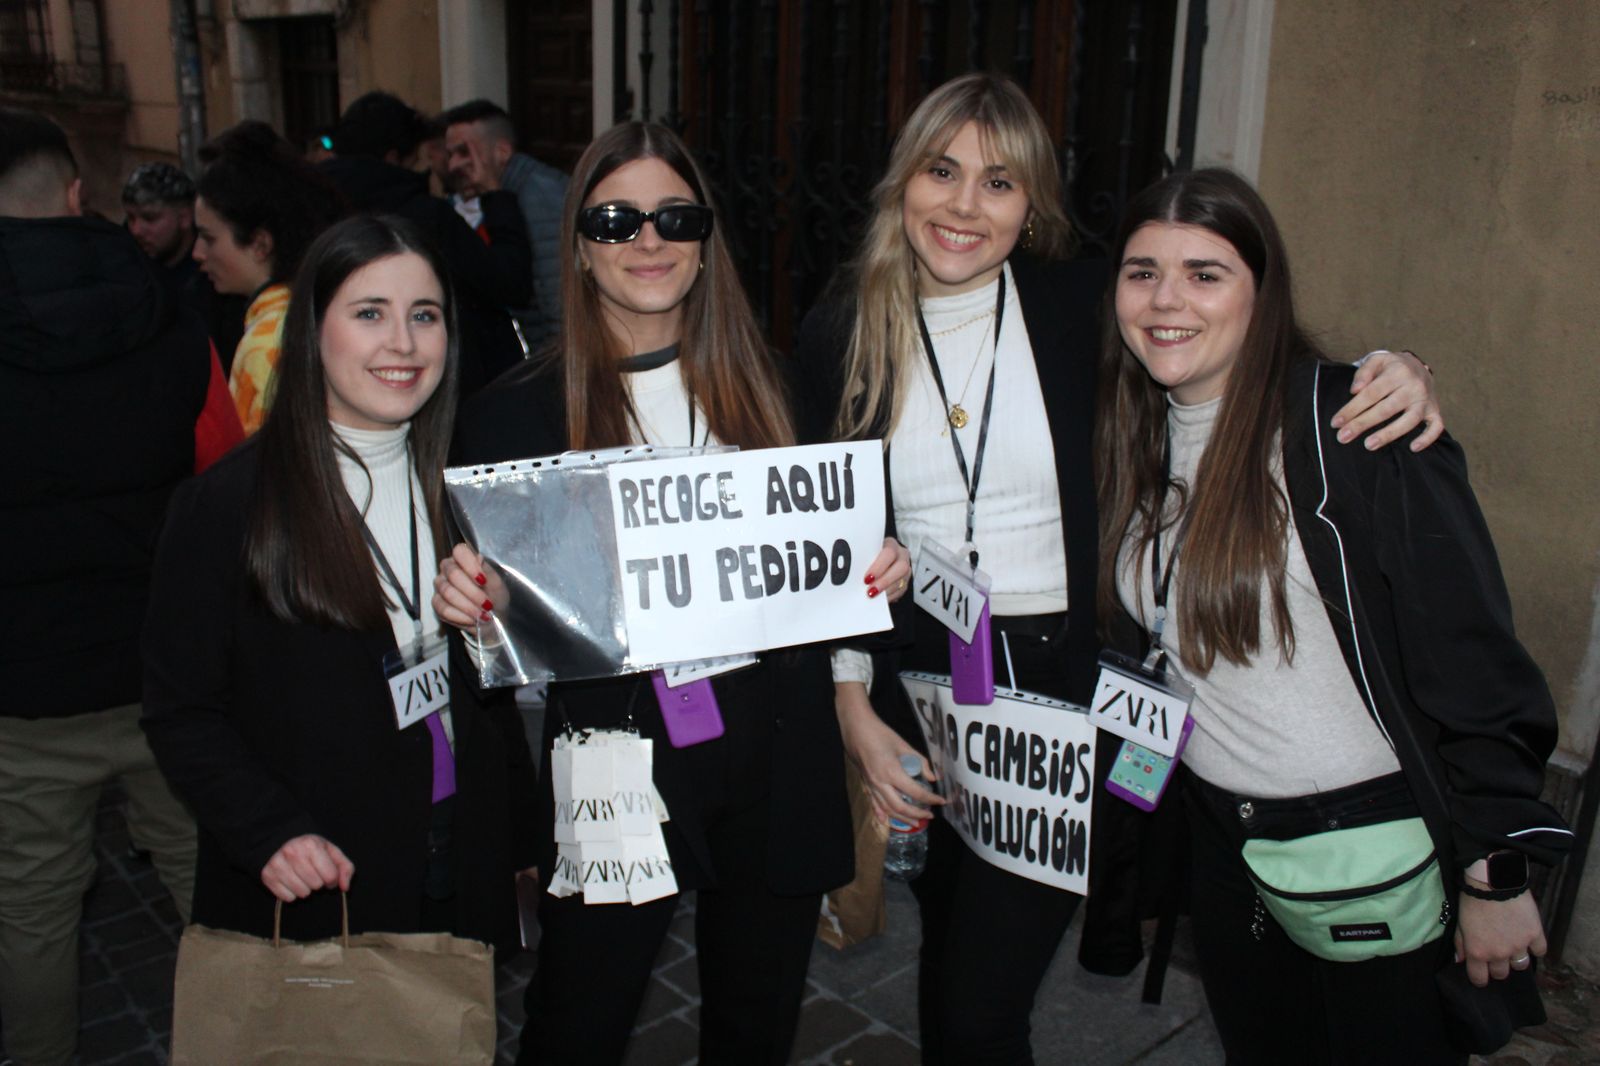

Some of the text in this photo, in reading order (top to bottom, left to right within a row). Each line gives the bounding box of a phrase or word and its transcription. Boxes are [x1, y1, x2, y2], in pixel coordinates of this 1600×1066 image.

[619, 453, 855, 528] RECOGE AQUÍ
[626, 553, 692, 610] TU
[920, 567, 969, 628] ZARA
[916, 697, 959, 762] SO
[1097, 683, 1168, 741] ZARA
[582, 859, 626, 884] ZARA
